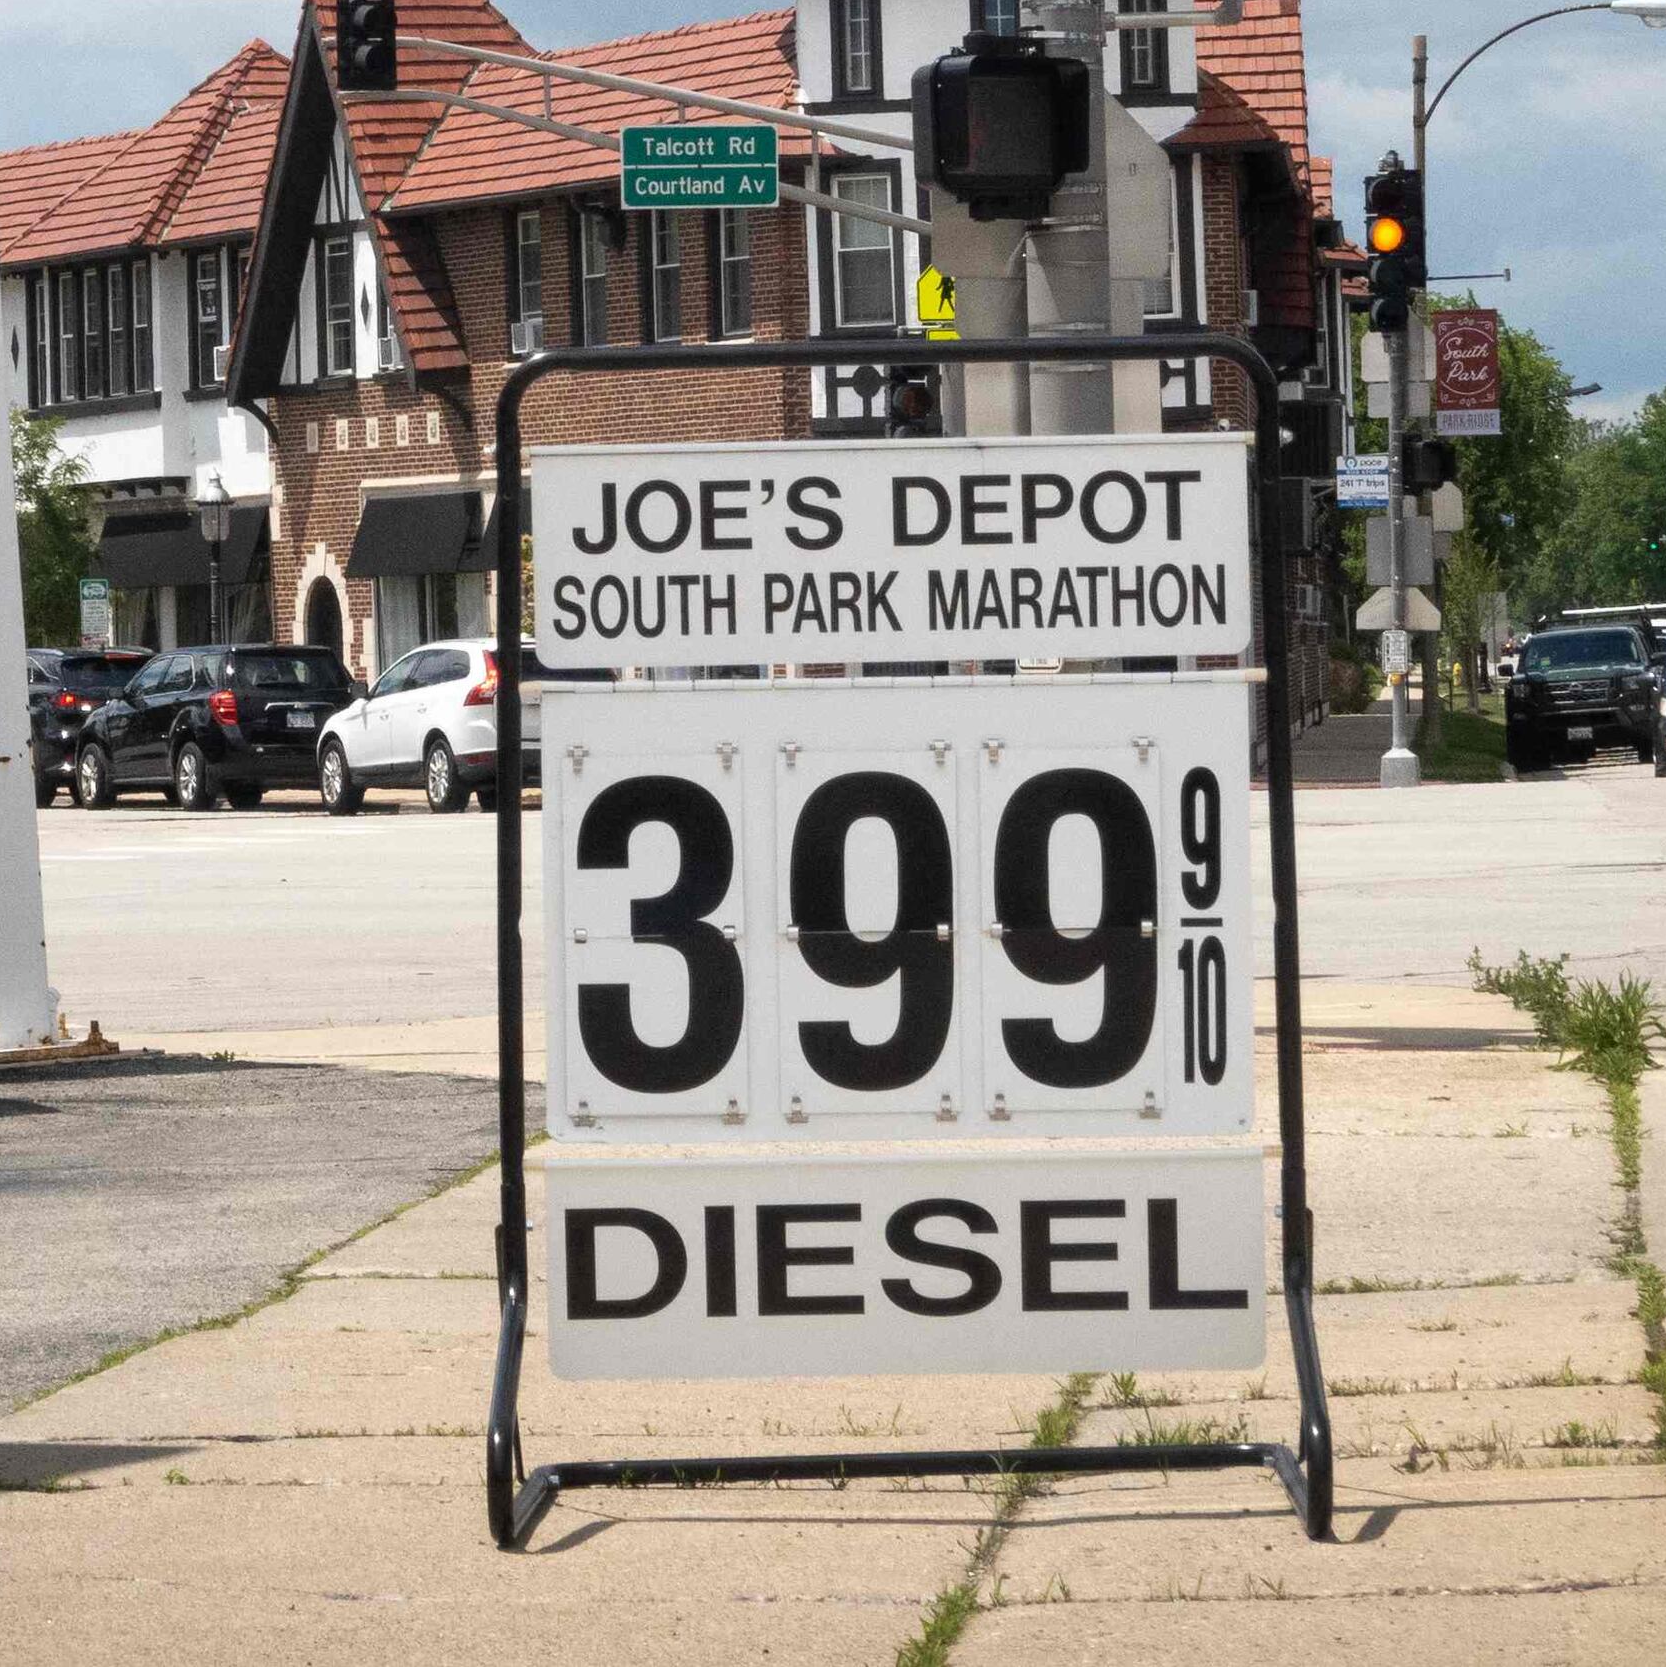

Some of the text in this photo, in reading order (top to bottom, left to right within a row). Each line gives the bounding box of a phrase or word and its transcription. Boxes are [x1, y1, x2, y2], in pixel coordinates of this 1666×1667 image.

[642, 136, 756, 156] Talcott Rd
[635, 174, 766, 196] Courtland Av
[1442, 337, 1490, 361] South
[1446, 361, 1489, 384] Park
[1443, 414, 1465, 430] PARK
[1340, 479, 1354, 488] 241
[1366, 478, 1385, 489] trips
[571, 469, 1203, 556] JOE'S DEPOT
[552, 562, 1228, 640] SOUTH PARK MARATHON
[563, 1196, 1251, 1322] DIESEL
